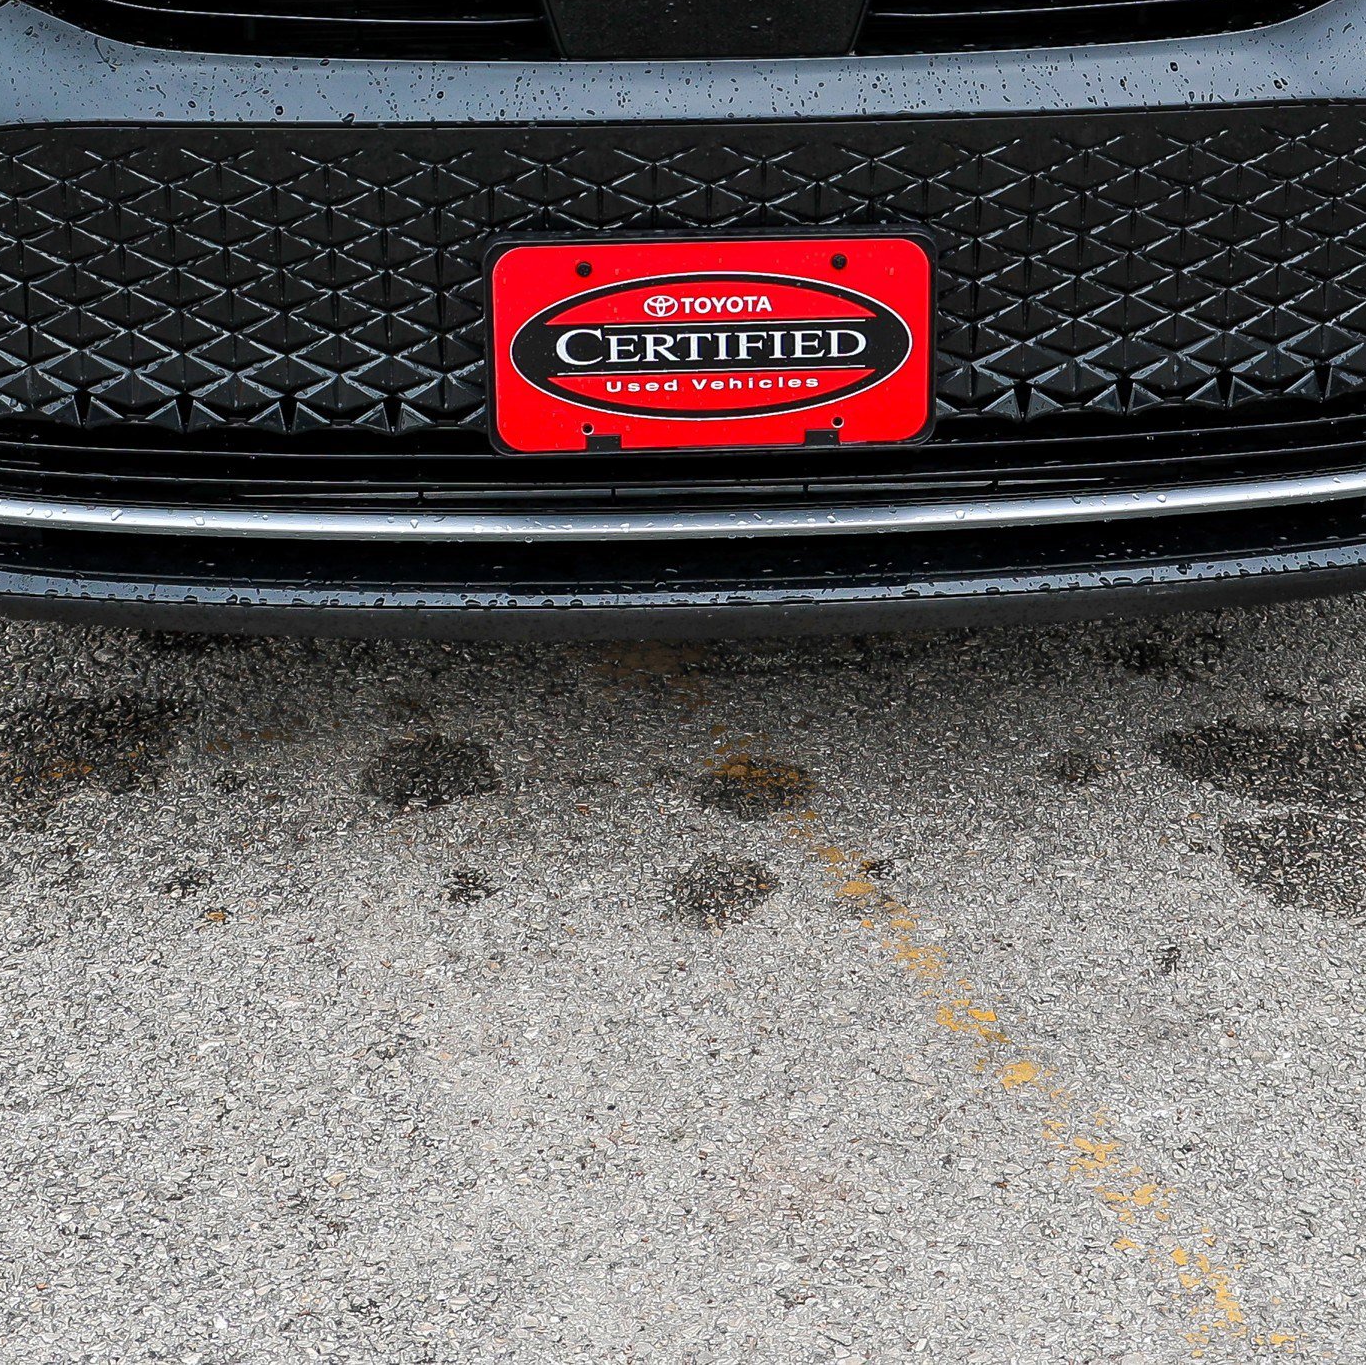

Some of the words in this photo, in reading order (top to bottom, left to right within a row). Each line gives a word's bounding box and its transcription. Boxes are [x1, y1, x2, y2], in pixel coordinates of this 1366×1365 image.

[681, 296, 772, 314] TOYOTA
[556, 329, 867, 366] CERTIFIED
[606, 379, 678, 392] Used
[692, 376, 819, 390] Vehicles
